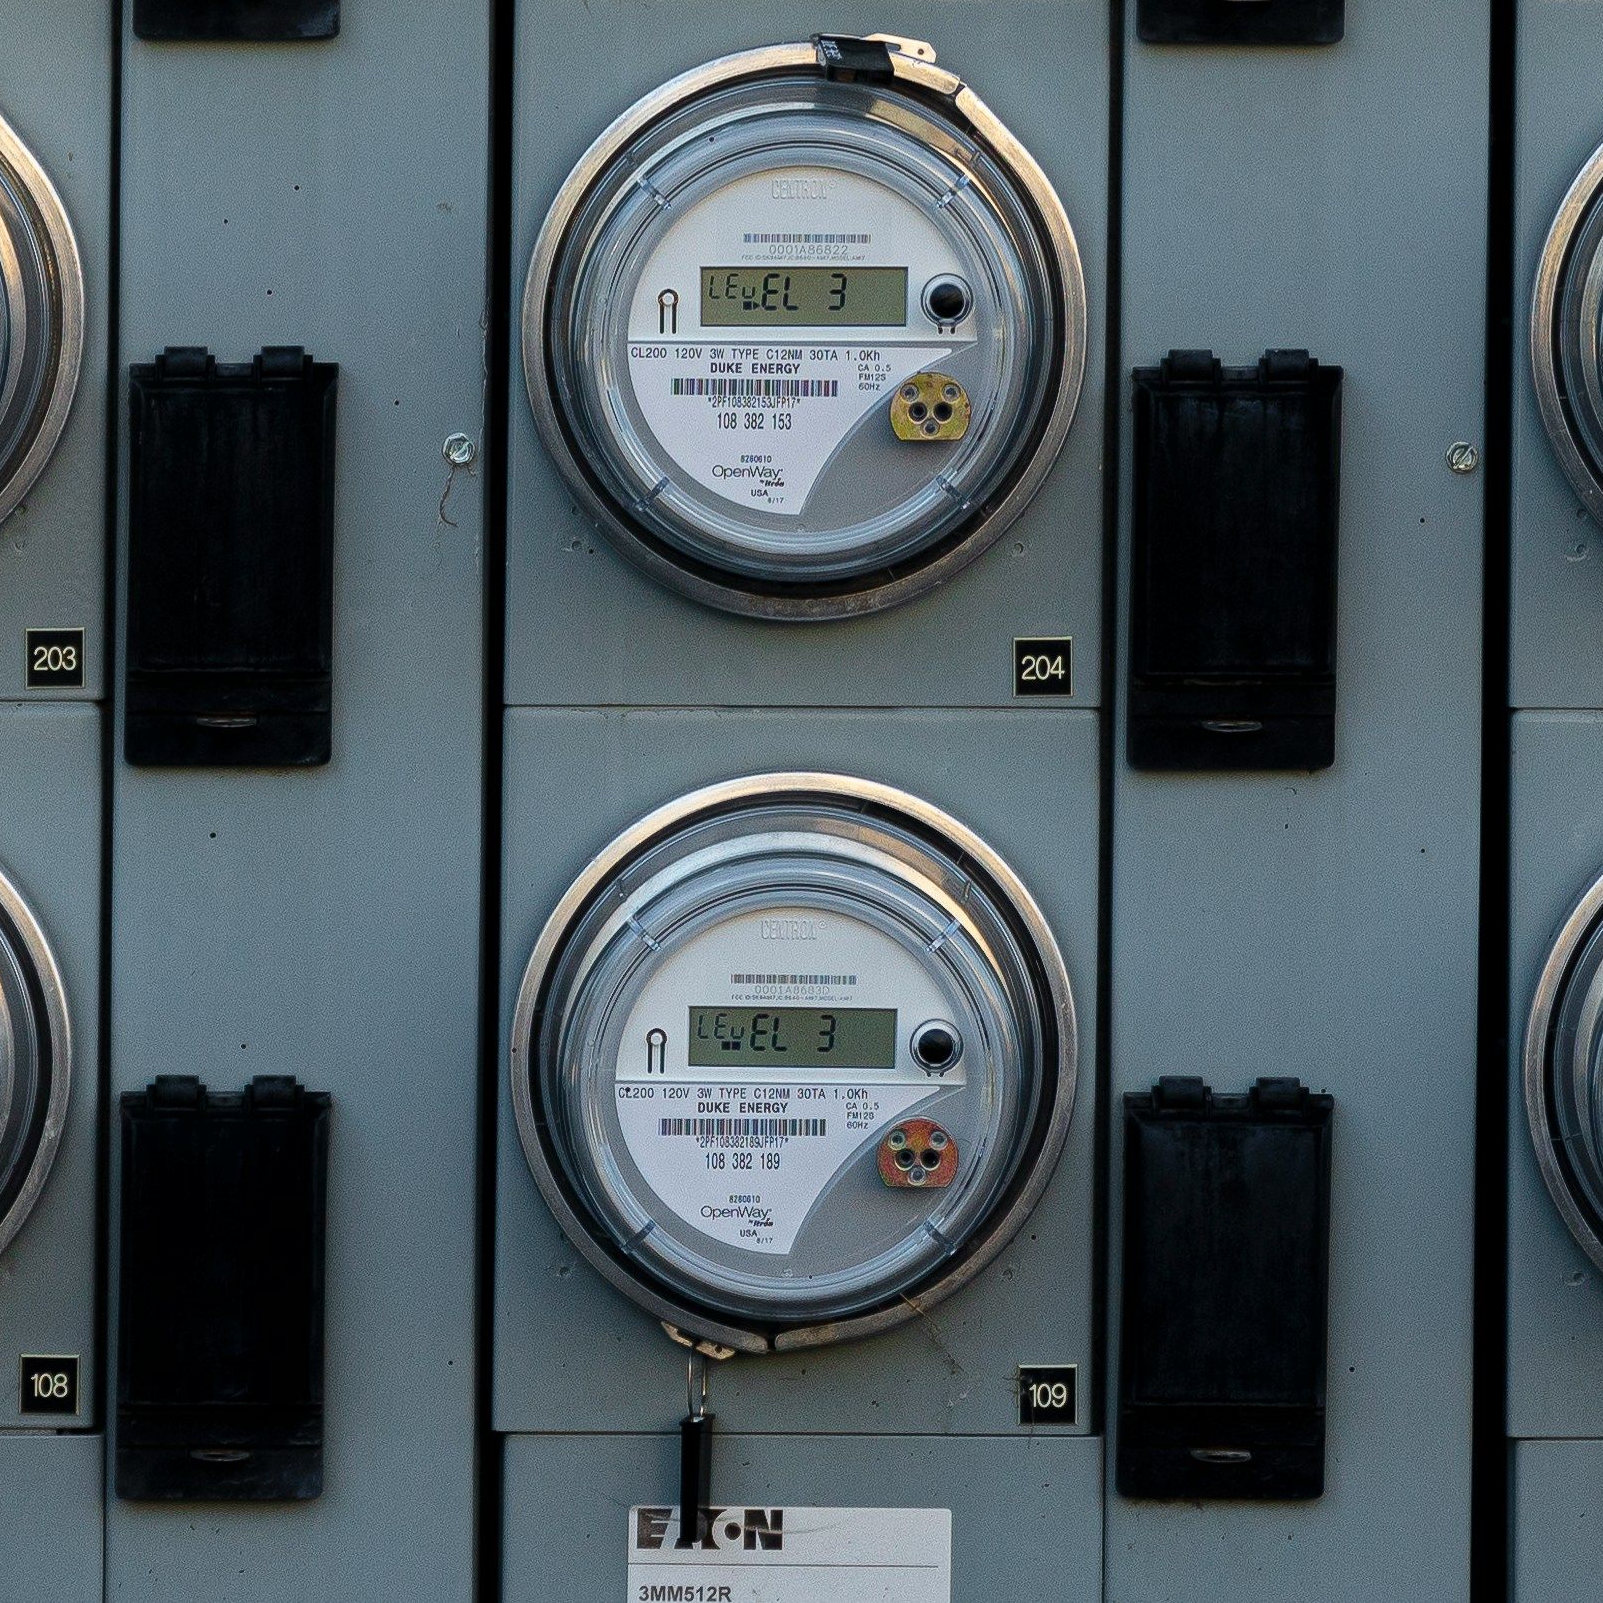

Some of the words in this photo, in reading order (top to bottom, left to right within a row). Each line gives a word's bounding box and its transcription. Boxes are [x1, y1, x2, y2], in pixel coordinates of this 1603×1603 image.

[710, 363, 742, 374] DUKE
[751, 363, 801, 374] ENERGY
[717, 414, 737, 430] 108
[743, 414, 764, 430] 382
[772, 414, 792, 430] 153
[710, 465, 780, 480] OpenWay
[34, 647, 76, 670] 203
[1022, 656, 1065, 680] 204
[698, 1102, 730, 1113] DUKE
[739, 1103, 789, 1113] ENERGY
[705, 1154, 725, 1170] 108
[731, 1154, 752, 1170] 382
[760, 1154, 781, 1170] 189
[31, 1374, 67, 1397] 108
[1029, 1384, 1066, 1408] 109
[638, 1585, 732, 1603] 3MM512R
